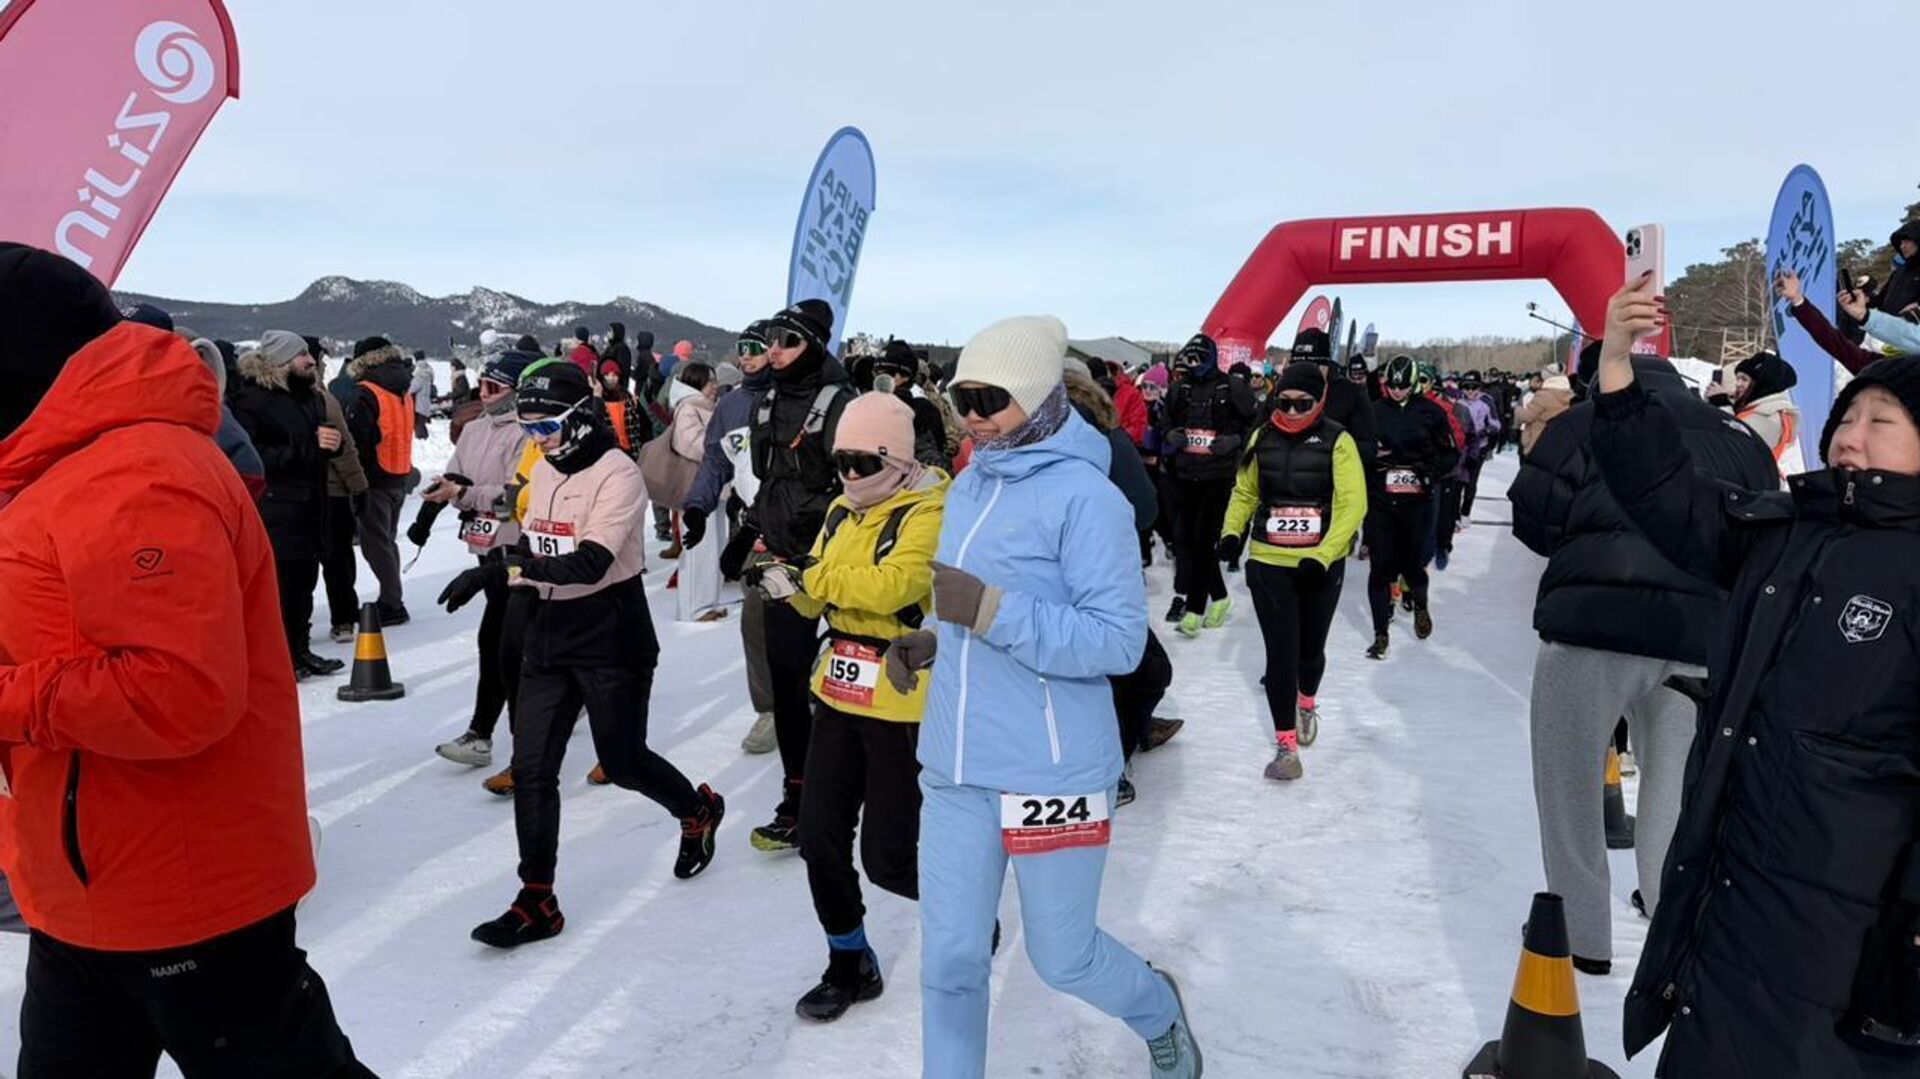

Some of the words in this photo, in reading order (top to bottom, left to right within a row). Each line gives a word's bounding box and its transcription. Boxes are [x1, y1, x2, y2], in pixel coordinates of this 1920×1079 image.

[1340, 221, 1512, 260] FINISH
[1393, 474, 1418, 485] 262
[1277, 519, 1309, 532] 223
[538, 536, 559, 556] 161
[831, 657, 860, 682] 159
[1022, 797, 1090, 827] 224
